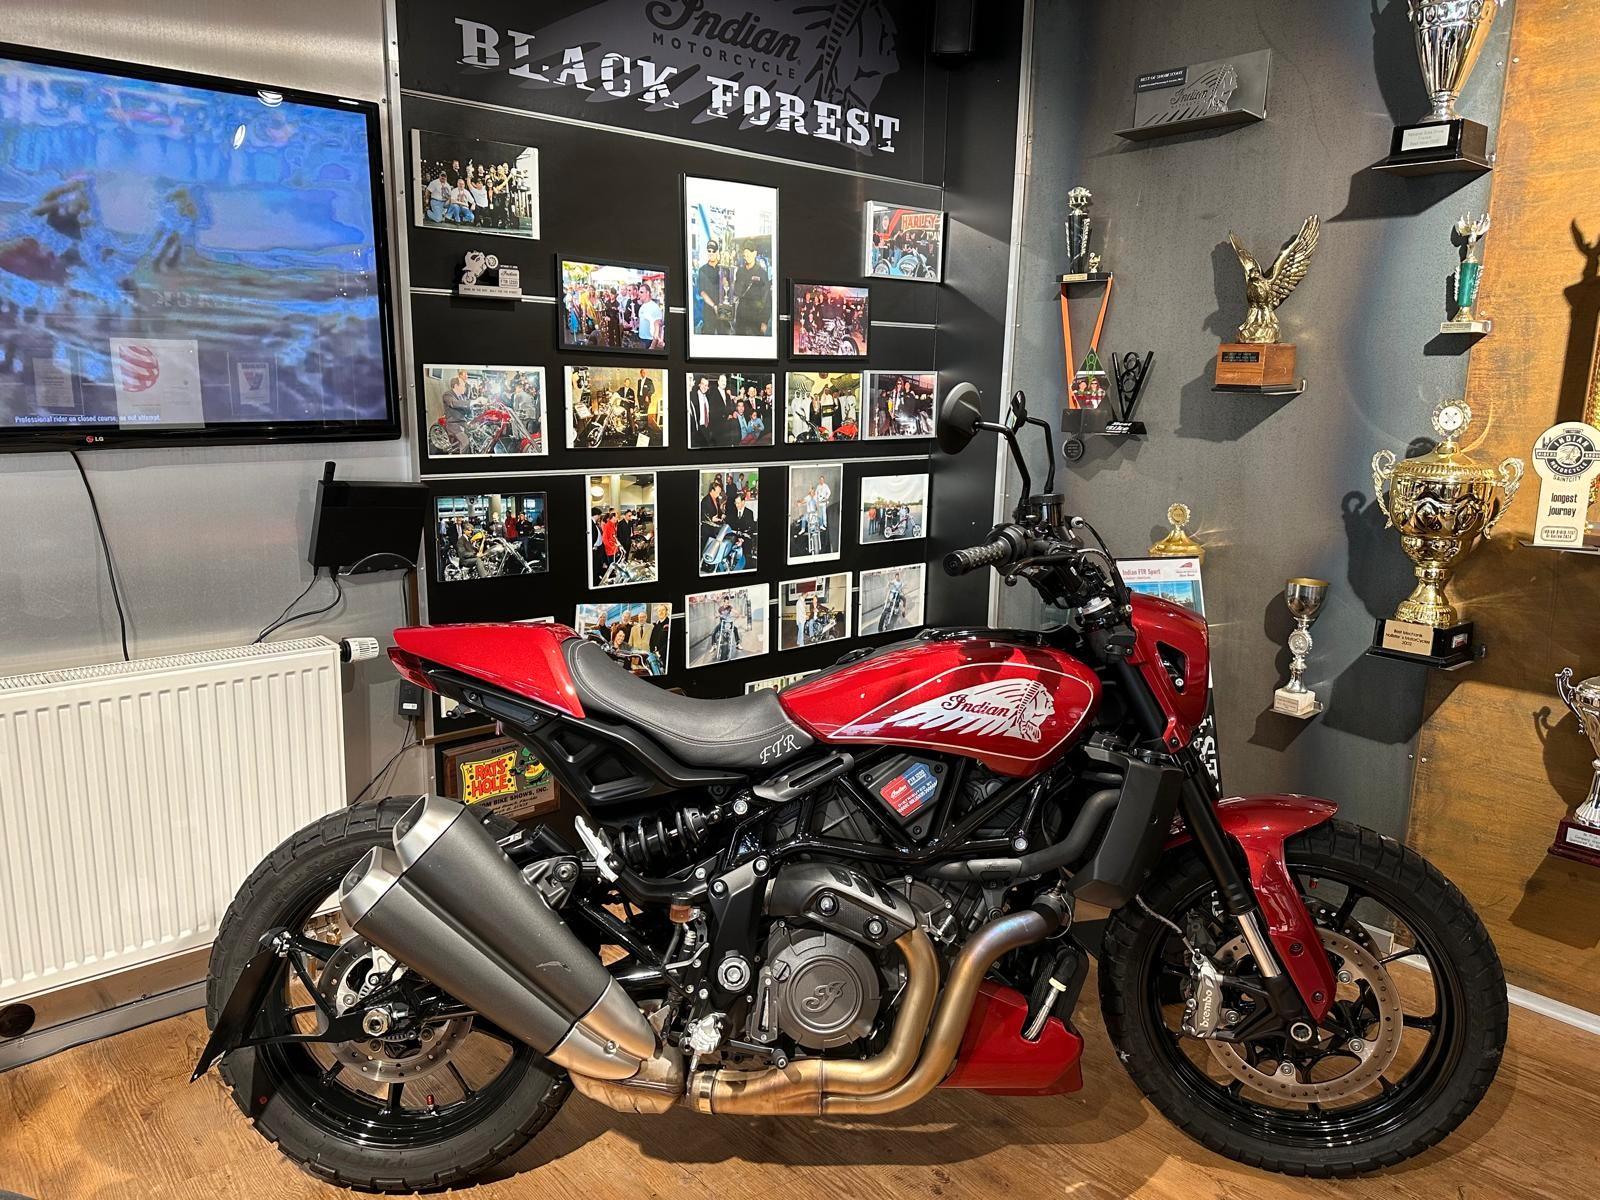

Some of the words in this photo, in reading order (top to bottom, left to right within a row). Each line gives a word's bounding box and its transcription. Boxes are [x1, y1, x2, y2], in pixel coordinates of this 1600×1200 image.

[645, 0, 802, 61] Indian
[652, 31, 795, 79] MOTORCYCLE
[455, 17, 680, 109] BLACK
[706, 75, 900, 153] FOREST
[902, 214, 936, 229] HARLEY
[1554, 436, 1589, 447] INDIAN
[1550, 460, 1588, 474] MOTORCYCLE
[1551, 493, 1577, 504] longest
[1547, 506, 1577, 517] journey
[941, 693, 1011, 718] Indian
[760, 734, 801, 765] FTR
[471, 774, 508, 798] HOLE
[890, 784, 908, 800] Indian
[493, 797, 508, 806] BIKE
[1200, 989, 1213, 1027] brembo
